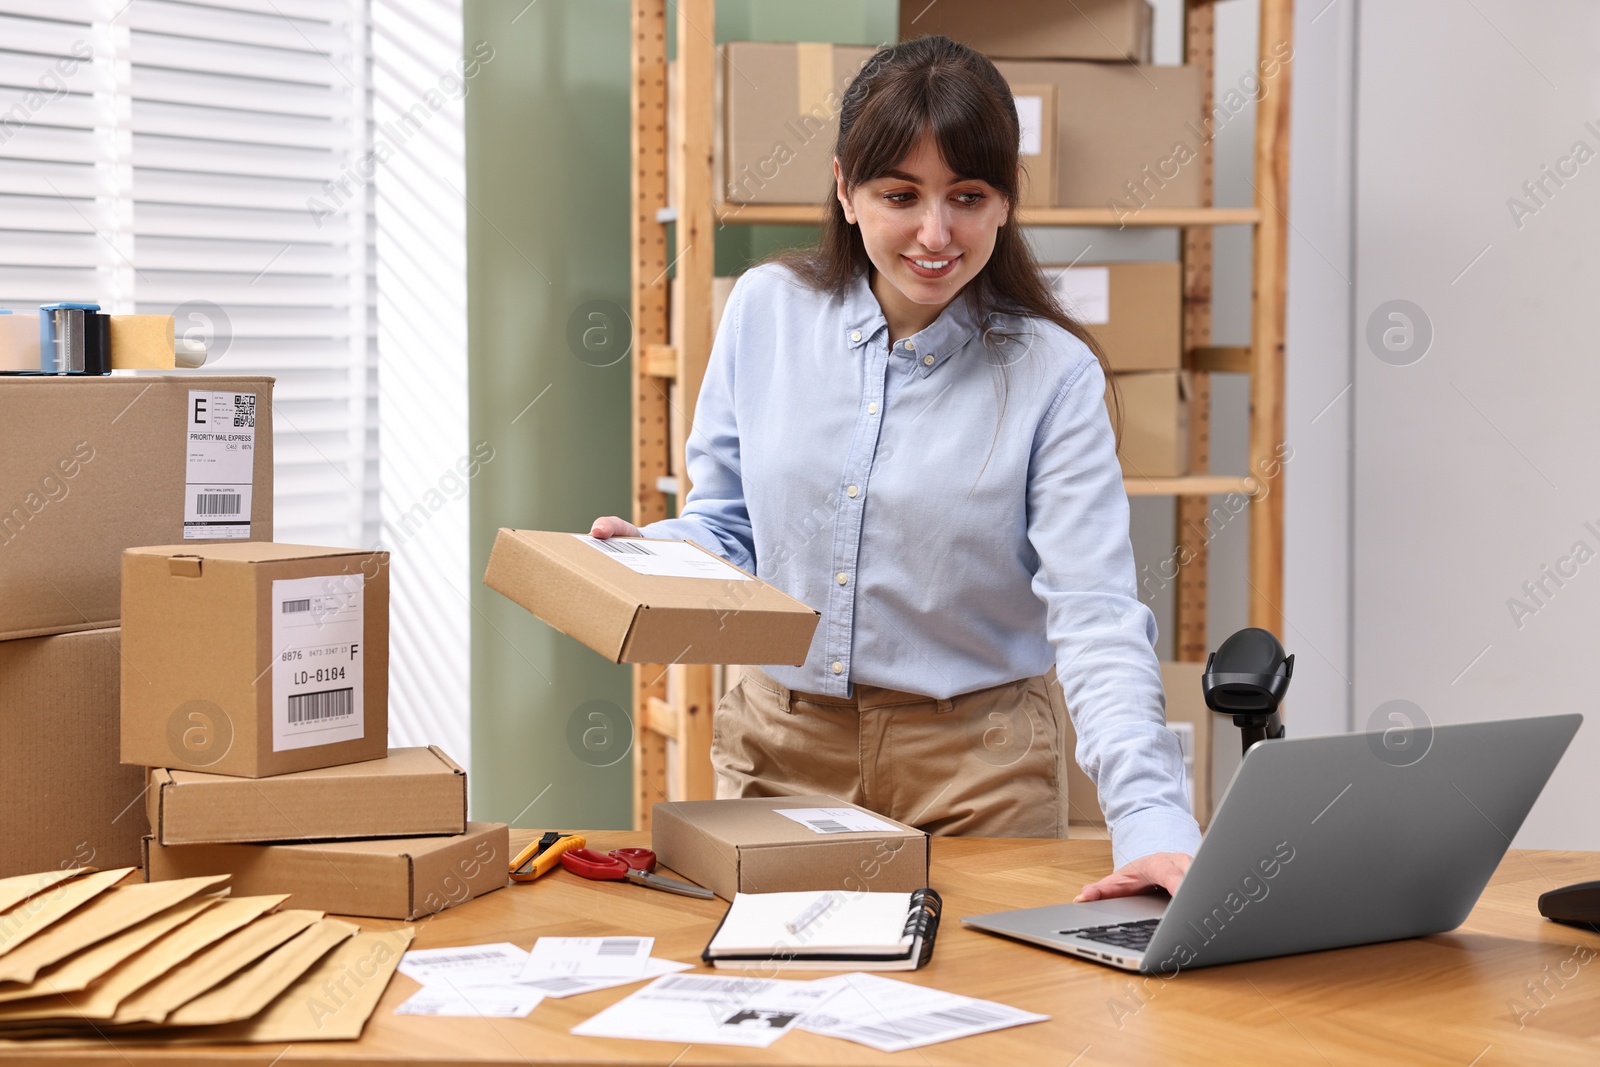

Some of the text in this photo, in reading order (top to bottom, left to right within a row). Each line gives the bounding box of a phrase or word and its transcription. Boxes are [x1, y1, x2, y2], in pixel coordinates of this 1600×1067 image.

[194, 398, 206, 424] E
[190, 434, 214, 442] PRIORITY
[282, 651, 302, 661] 0876
[350, 644, 358, 660] F
[294, 666, 345, 685] LD-0104
